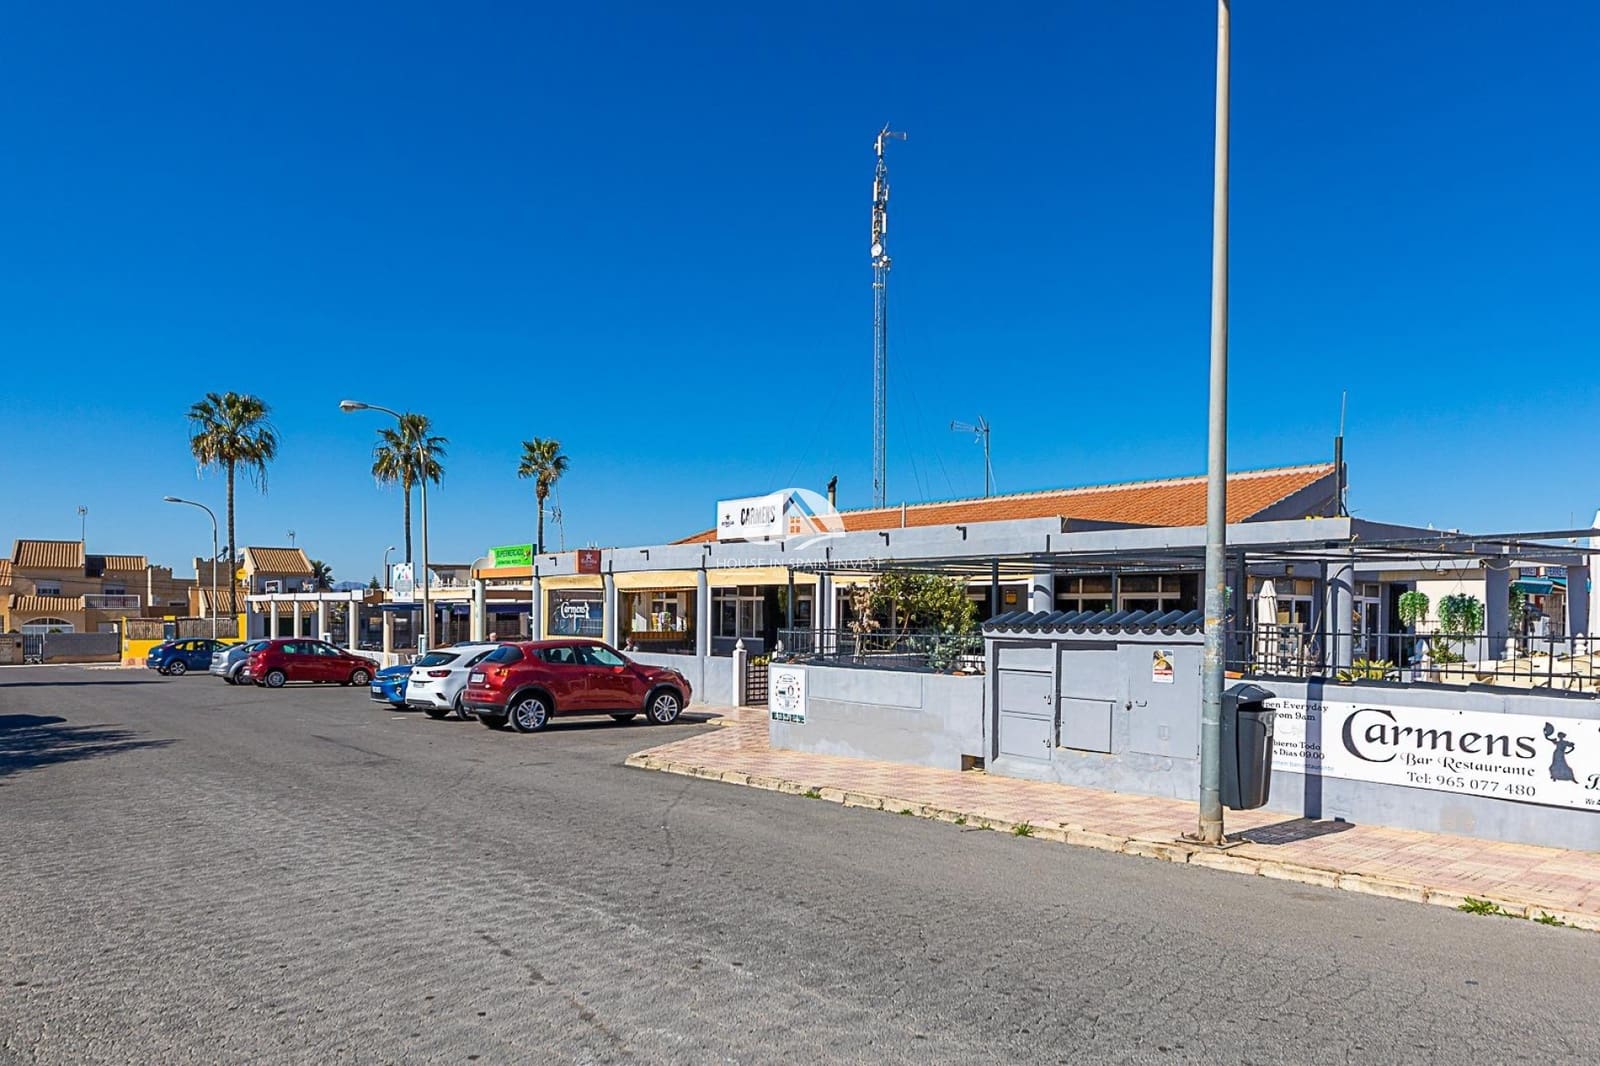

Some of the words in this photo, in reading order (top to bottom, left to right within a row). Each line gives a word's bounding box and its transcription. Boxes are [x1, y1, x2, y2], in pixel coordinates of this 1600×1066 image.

[740, 505, 776, 526] CARMENS
[1283, 701, 1329, 712] Everyday
[1295, 712, 1316, 721] 9am
[1273, 739, 1298, 748] bierto
[1300, 741, 1321, 751] Todo
[1342, 708, 1536, 763] Carmens
[1400, 751, 1434, 767] Bar
[1437, 755, 1536, 777] Restaurante
[1406, 770, 1433, 785] Tel:
[1435, 774, 1465, 789] 965
[1469, 777, 1499, 792] 077
[1504, 782, 1537, 797] 480
